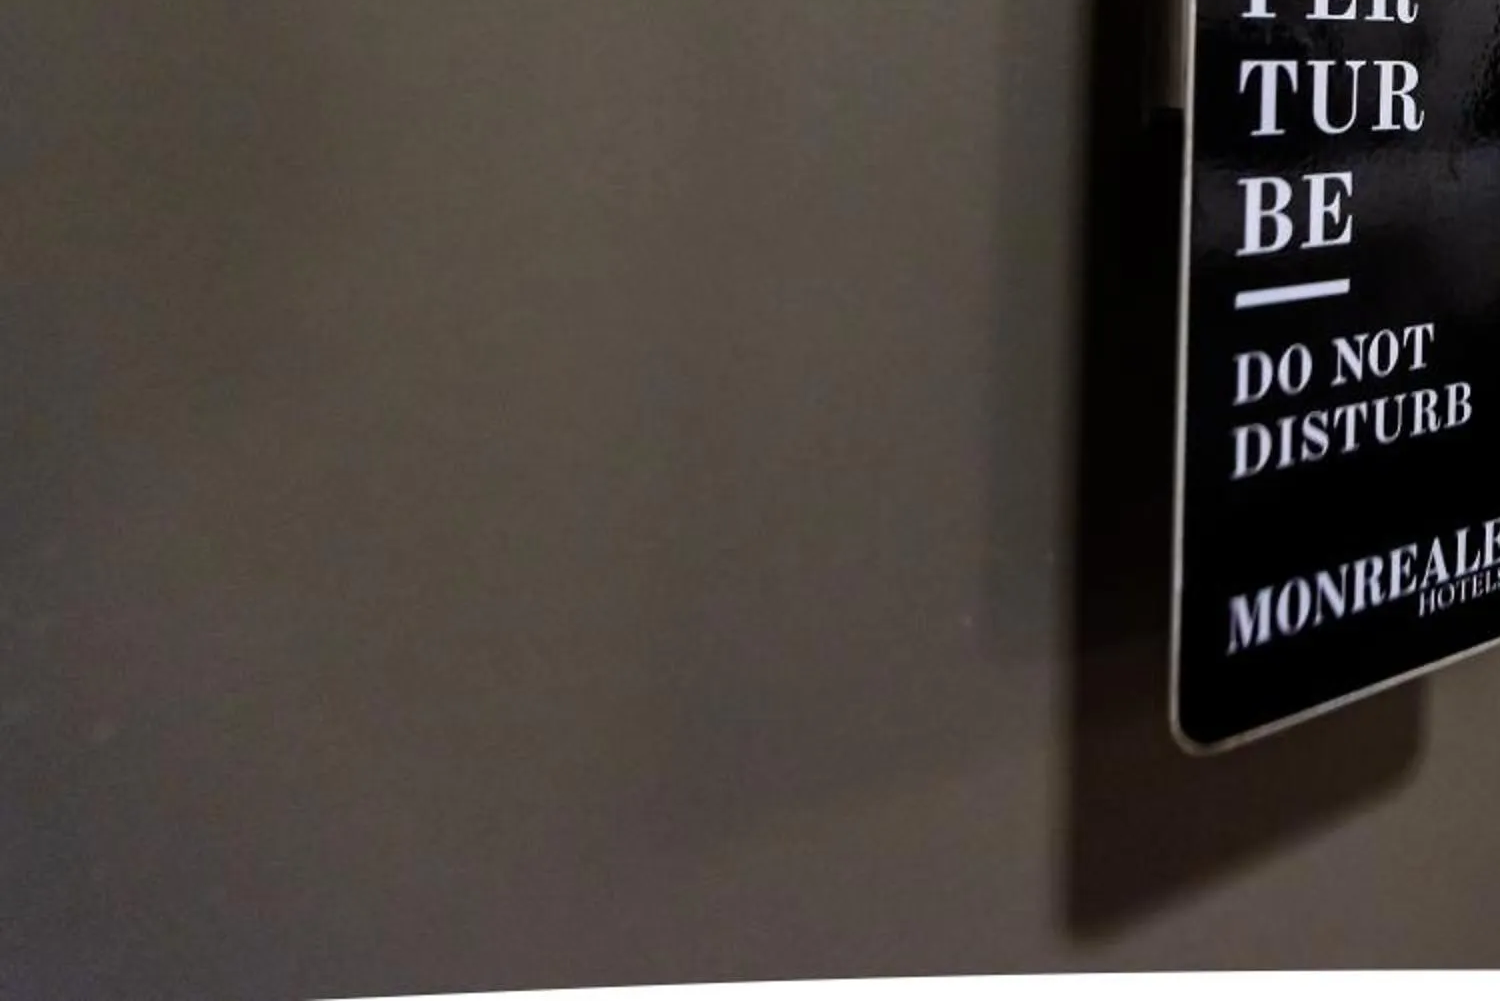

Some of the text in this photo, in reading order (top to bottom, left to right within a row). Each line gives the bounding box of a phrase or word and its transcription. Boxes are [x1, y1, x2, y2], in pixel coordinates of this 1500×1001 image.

[1238, 59, 1425, 136] TUR
[1235, 170, 1354, 257] BE
[1232, 322, 1435, 406] DO NOT
[1230, 381, 1473, 480] DISTURB
